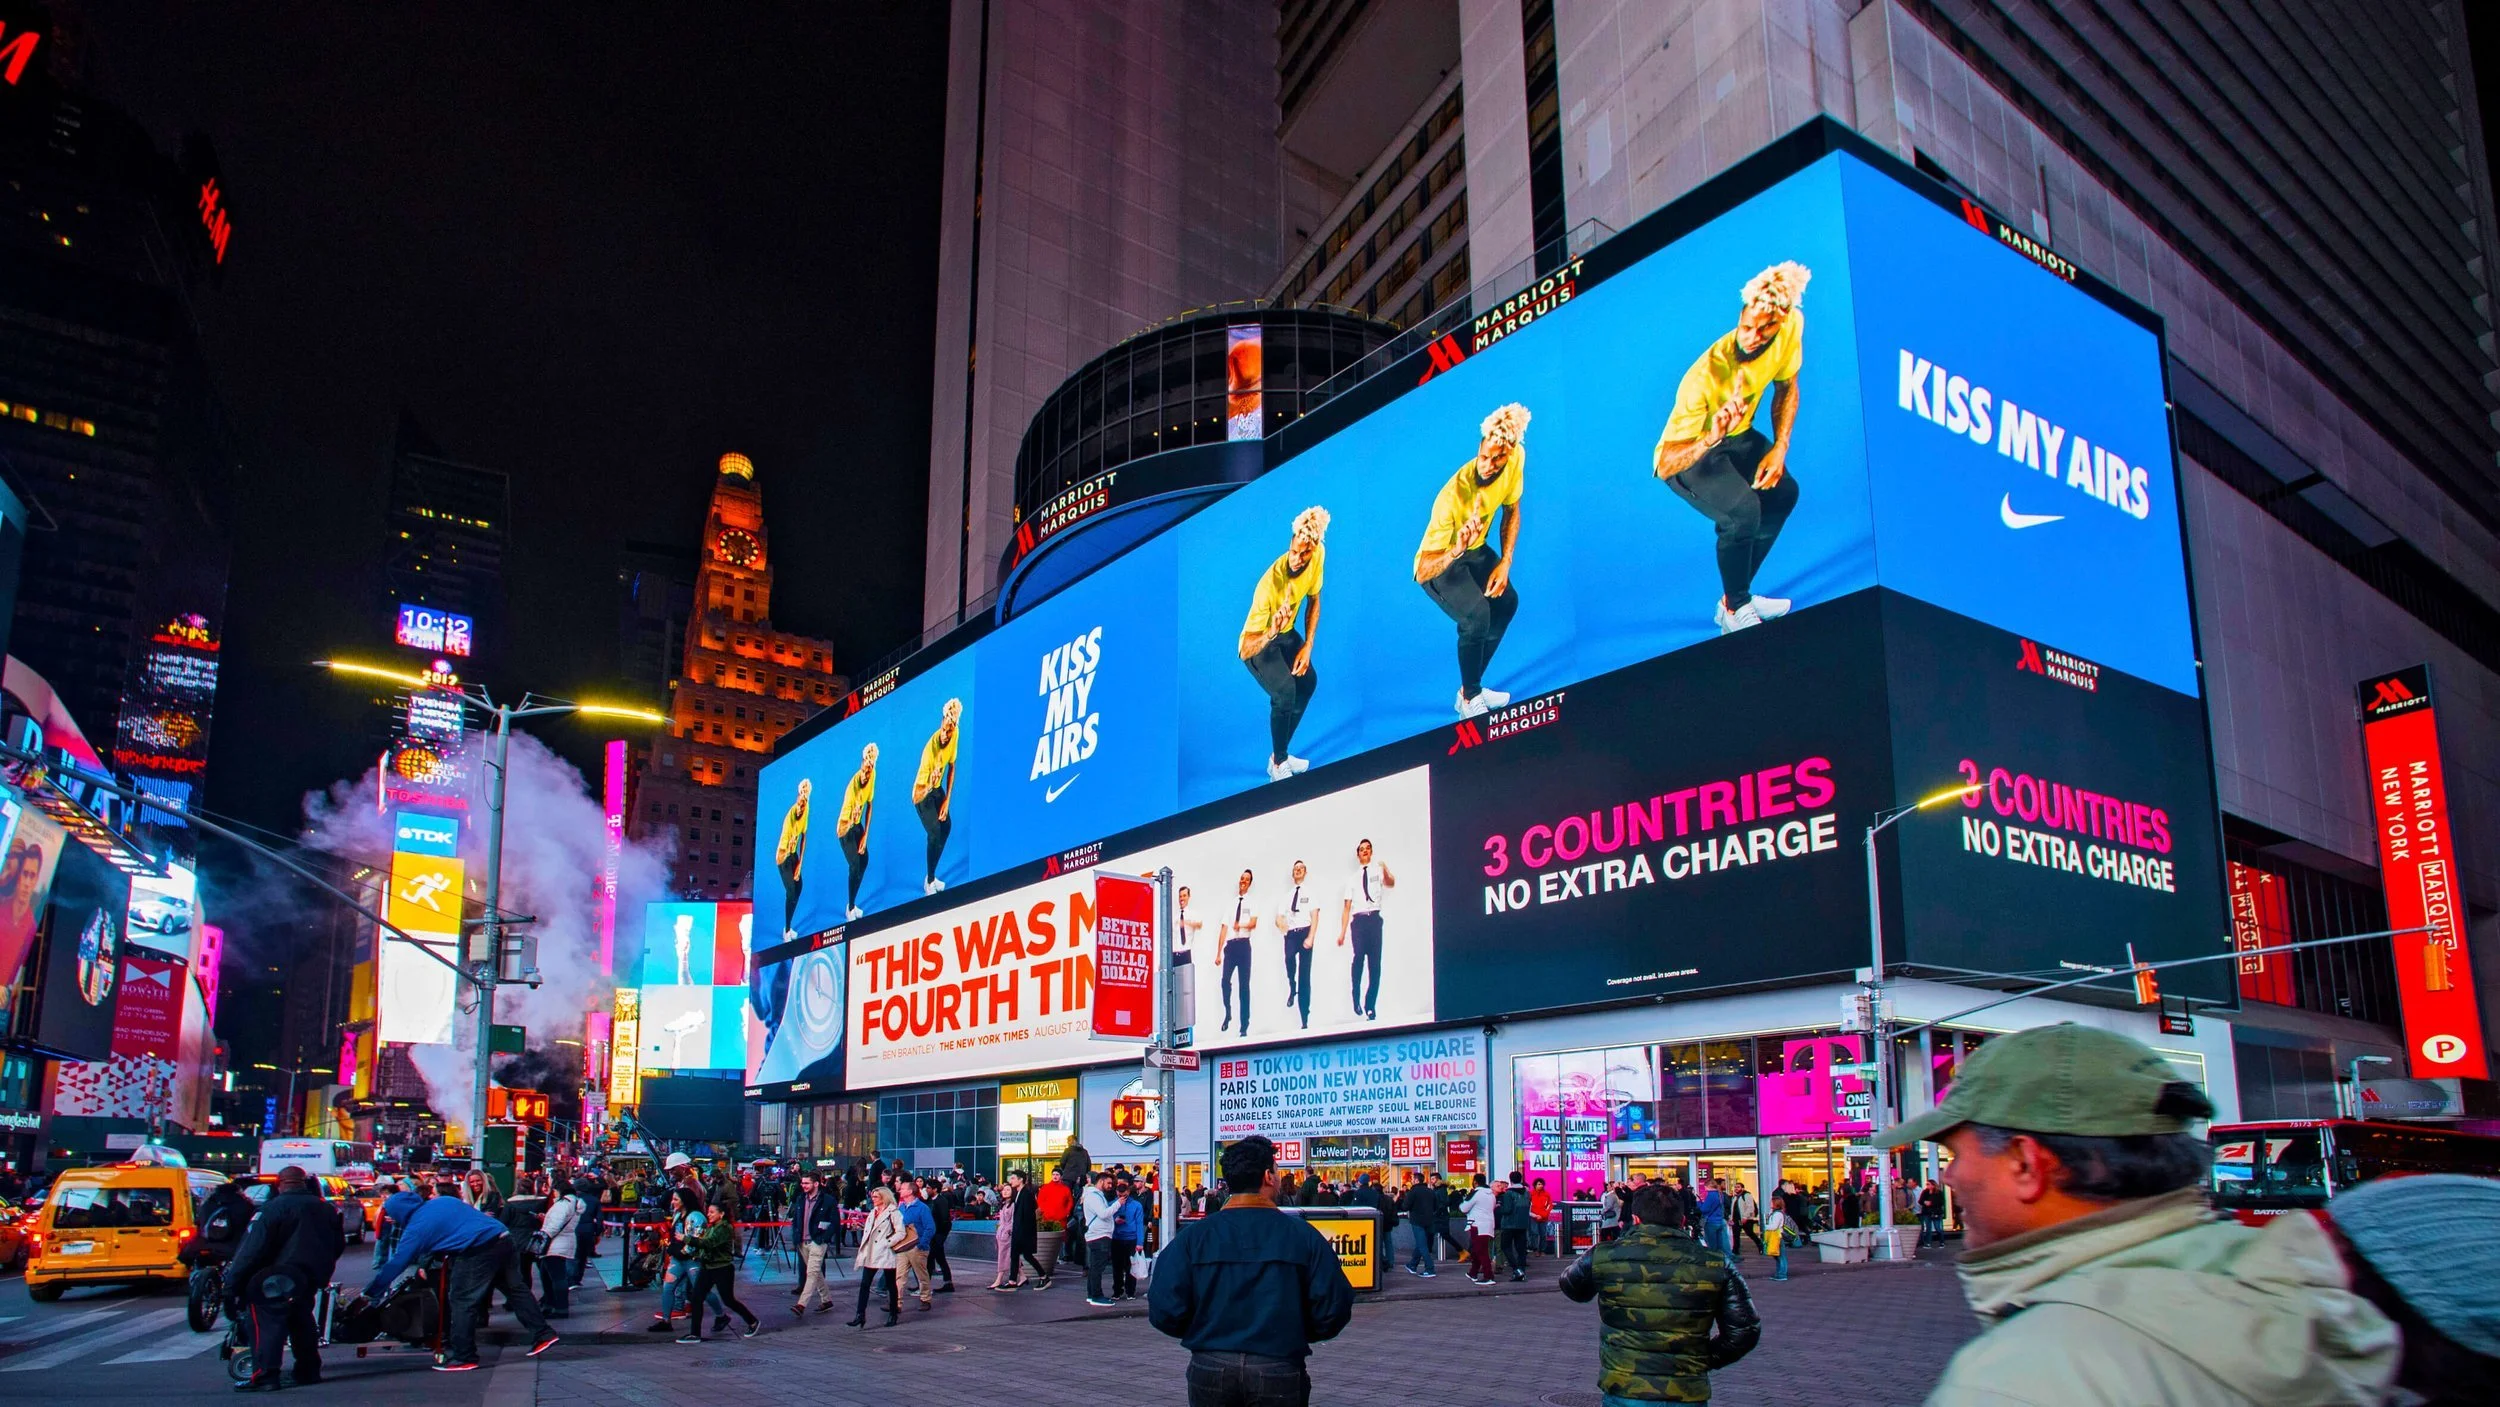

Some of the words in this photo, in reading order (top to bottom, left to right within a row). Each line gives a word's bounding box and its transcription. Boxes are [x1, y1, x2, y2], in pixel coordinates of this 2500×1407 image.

[2000, 224, 2076, 280] MARRIOTT
[1475, 259, 1584, 334] MARRIOTT
[1475, 286, 1571, 351] MARQUIS
[1898, 348, 1992, 445] KISS
[1997, 399, 2065, 479] MY
[2066, 435, 2149, 520] AIRS
[1041, 472, 1117, 521] MARRIOTT
[1041, 494, 1105, 537] MARQUIS
[404, 609, 469, 638] 10:32
[1039, 626, 1102, 696] KISS
[2046, 650, 2098, 677] MARRIOTT
[863, 667, 900, 695] MARRIOTT
[2048, 665, 2094, 690] MARQUIS
[411, 696, 461, 712] TOSHIBA
[863, 681, 895, 706] MARQUIS
[1043, 670, 1096, 734] MY
[1489, 693, 1565, 725] MARRIOTT
[2376, 695, 2427, 714] MARRIOTT
[1490, 710, 1556, 738] MARQUIS
[1030, 712, 1099, 781] AIRS
[413, 772, 453, 786] 2017
[2381, 767, 2403, 806] NEW
[386, 788, 469, 809] TOSHIBA
[1959, 758, 1981, 808] 3
[1990, 768, 2172, 854] COUNTRIES
[2409, 761, 2439, 856] MARRIOTT
[1484, 835, 1509, 876] 3
[1521, 756, 1836, 868] COUNTRIES
[411, 828, 453, 844] TDK
[2388, 812, 2410, 862] YORK
[1063, 842, 1103, 860] MARRIOTT
[1962, 816, 2000, 857] NO
[2005, 826, 2084, 875] EXTRA
[2087, 845, 2176, 893] CHARGE
[1063, 854, 1098, 870] MARQUIS
[1484, 878, 1531, 915] NO
[1539, 854, 1655, 904] EXTRA
[1663, 813, 1838, 879] CHARGE
[823, 926, 846, 937] MARRIOTT
[1101, 916, 1149, 936] BETTE
[823, 934, 843, 945] MARQUIS
[953, 901, 1057, 973] WAS
[1098, 931, 1152, 951] MIDLER
[1101, 950, 1149, 970] HELLO,
[1101, 965, 1149, 984] DOLLY!
[1607, 976, 1633, 986] Coverage
[1643, 973, 1657, 981] avail.
[1664, 970, 1680, 978] some
[1681, 968, 1699, 976] areas.
[121, 984, 146, 994] BOW
[153, 989, 170, 997] TIE
[862, 969, 1019, 1045] FOURTH
[882, 1050, 897, 1060] BEN
[898, 1044, 936, 1058] BRANTLEY
[939, 1041, 955, 1051] THE
[956, 1038, 975, 1049] NEW
[978, 1034, 1001, 1046] YORK
[1003, 1029, 1029, 1043] TIMES
[1034, 1022, 1072, 1038] AUGUST
[1075, 1019, 1090, 1034] 20,
[1178, 1033, 1189, 1041] WAY
[615, 1047, 634, 1057] KING
[1161, 1055, 1176, 1064] ONE
[1179, 1056, 1194, 1065] WAY
[1254, 1055, 1303, 1075] TOKYO
[1310, 1051, 1330, 1070] TO
[1337, 1045, 1389, 1067] TIMES
[1397, 1037, 1475, 1063] SQUARE
[2436, 1041, 2454, 1058] P
[1220, 1080, 1257, 1096] PARIS
[1263, 1075, 1317, 1093] LONDON
[1324, 1070, 1357, 1088] NEW
[1363, 1066, 1402, 1085] YORK
[1411, 1060, 1475, 1080] UNIQLO
[1016, 1082, 1061, 1099] INVICTA
[1220, 1098, 1247, 1110] HONG
[1252, 1096, 1279, 1108] KONG
[1285, 1091, 1337, 1106] TORONTO
[1343, 1085, 1407, 1102] SHANGHAI
[1416, 1081, 1476, 1097] CHICAGO
[1846, 1093, 1869, 1106] ONE
[534, 1101, 545, 1117] 10
[1132, 1107, 1143, 1126] 10
[1220, 1114, 1235, 1122] LOS
[1236, 1111, 1272, 1121] ANGELES
[1277, 1108, 1324, 1119] SINGAPORE
[1330, 1105, 1373, 1116] ANTWERP
[1379, 1102, 1409, 1113] SEOUL
[1414, 1098, 1476, 1110] MELBOURNE
[28, 1113, 41, 1129] hut
[1220, 1124, 1256, 1133] UNIQLO.COM
[1258, 1122, 1287, 1131] SEATTLE
[1290, 1120, 1313, 1129] KUALA
[1315, 1118, 1343, 1128] LUMPUR
[1347, 1117, 1376, 1126] MOSCOW
[1381, 1115, 1410, 1125] MANILA
[1415, 1114, 1430, 1123] SAN
[1432, 1112, 1477, 1122] FRANCISCO
[1362, 1126, 1398, 1134] PHILADELPHIA
[1532, 1118, 1552, 1131] ALL
[1286, 1143, 1299, 1151] UNI
[1310, 1146, 1349, 1158] LifeWear
[1352, 1145, 1387, 1159] Pop-Up
[1414, 1147, 1430, 1155] QLO
[1415, 1139, 1429, 1147] UNI
[1286, 1151, 1299, 1159] QLO
[1533, 1153, 1556, 1167] ALL
